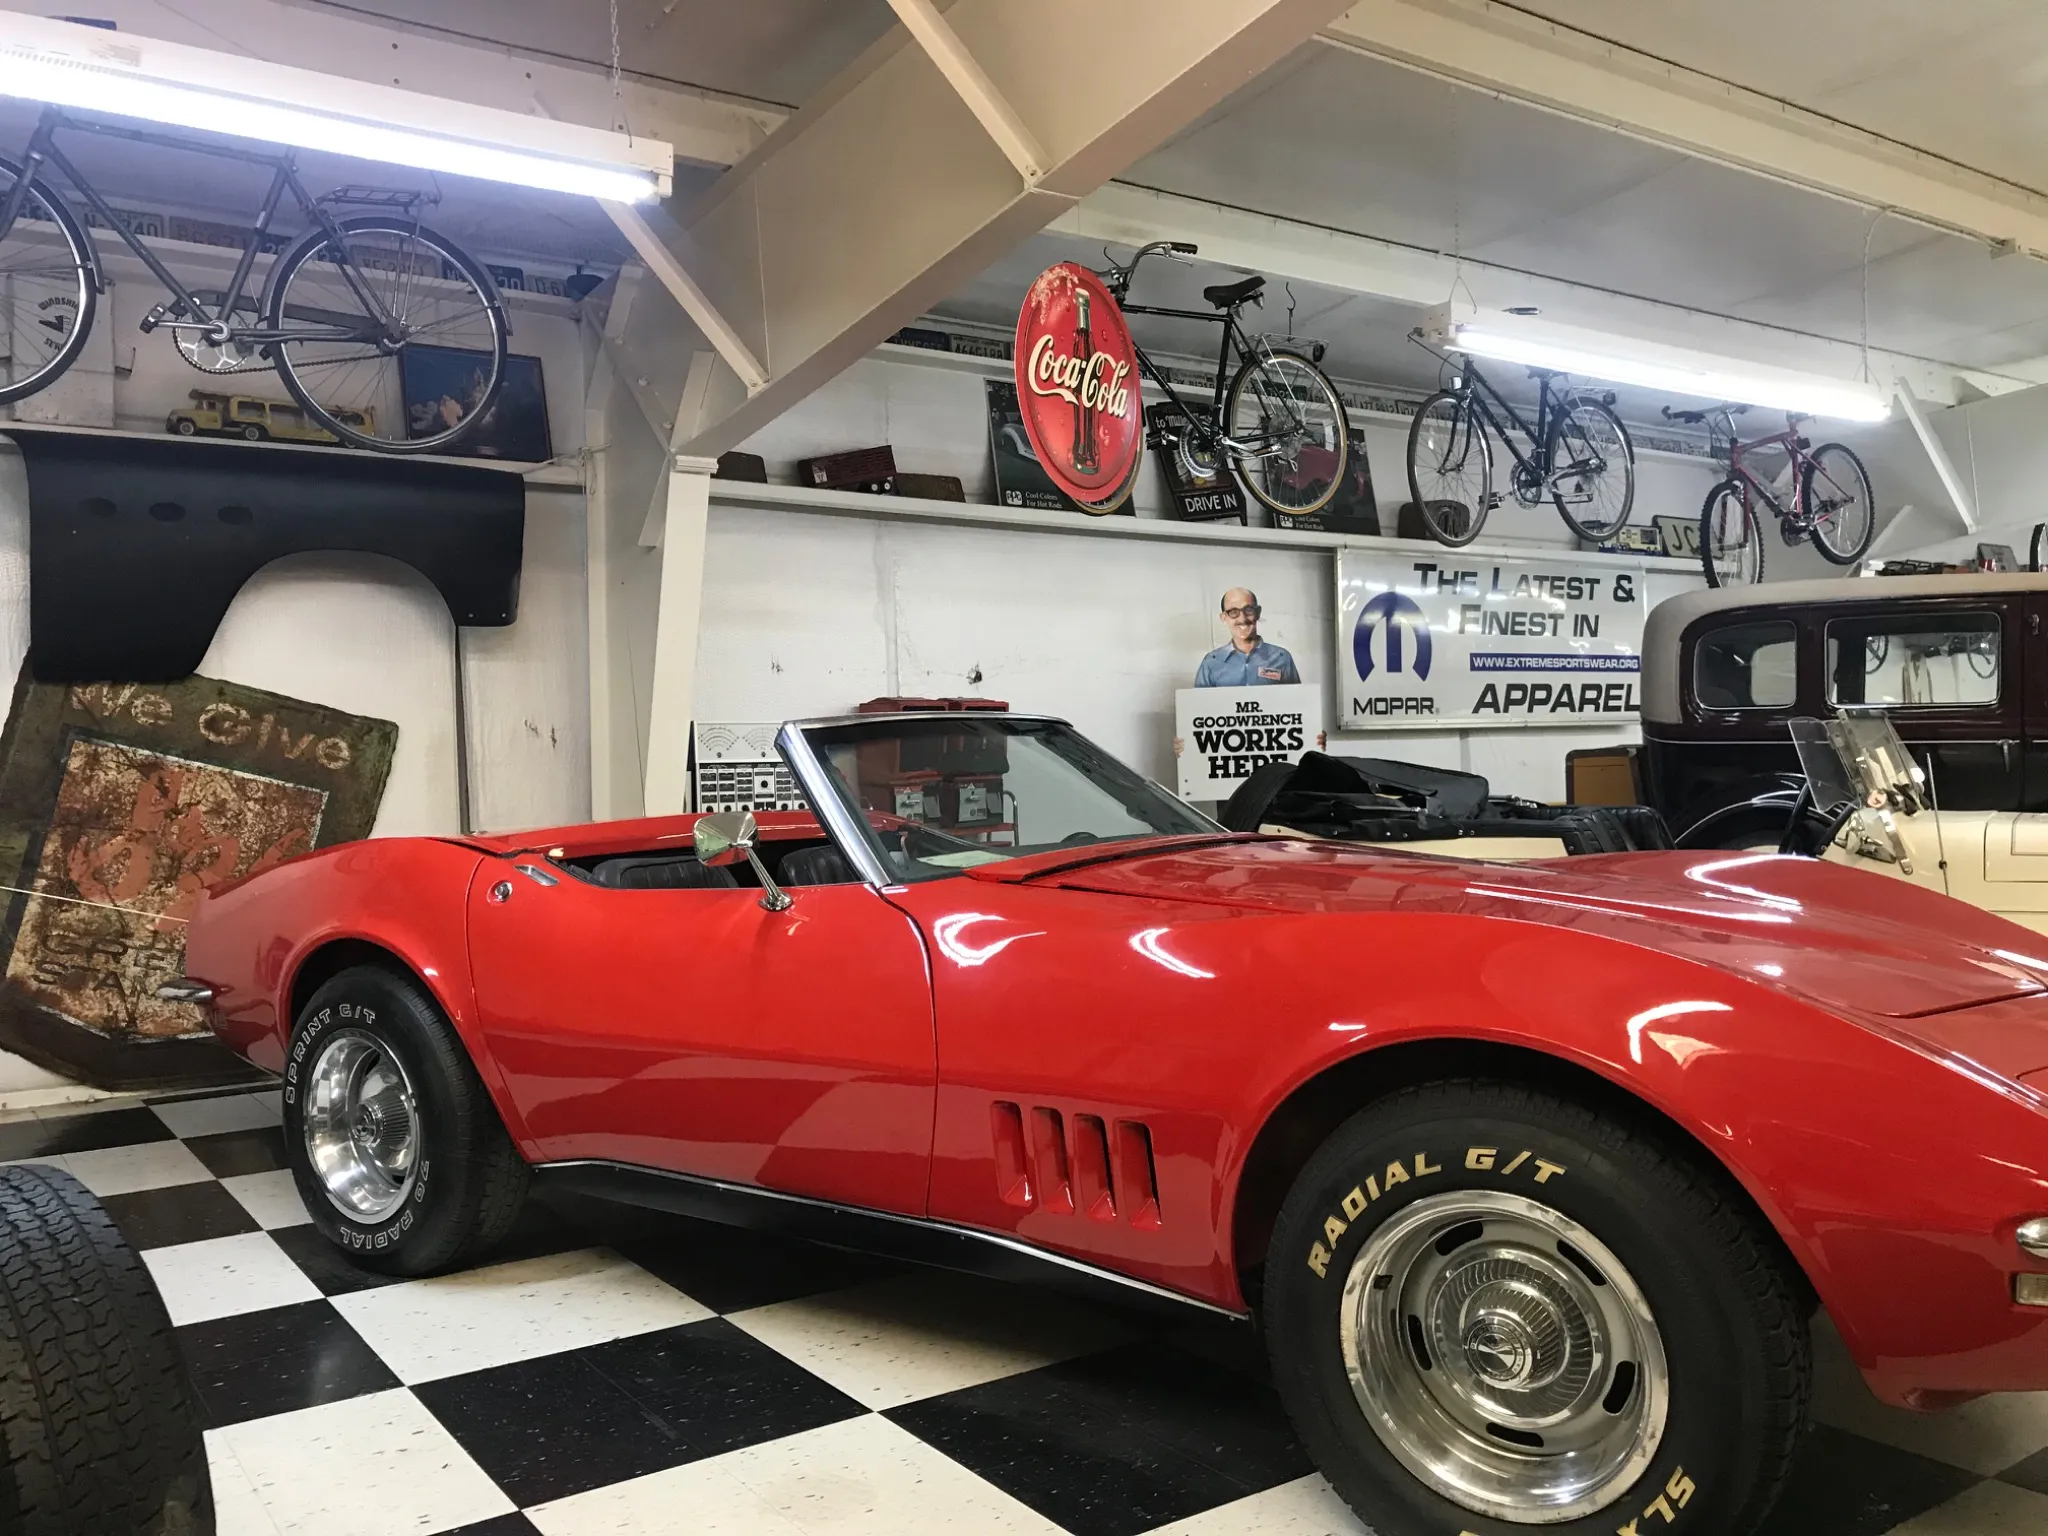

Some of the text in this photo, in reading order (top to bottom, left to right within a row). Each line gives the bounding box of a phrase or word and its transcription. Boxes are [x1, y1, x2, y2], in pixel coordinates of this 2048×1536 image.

[1155, 416, 1166, 428] to
[1025, 491, 1039, 499] Cool
[1184, 494, 1238, 512] DRIVE IN
[1413, 563, 1635, 603] THE LATEST &
[1458, 604, 1599, 638] FINEST IN
[1472, 656, 1639, 670] WWW.EXTREMESPORTSWEAR.ORG
[1235, 701, 1263, 713] MR.
[1353, 697, 1434, 716] MOPAR
[1471, 683, 1641, 714] APPAREL
[1193, 713, 1303, 729] GOODWRENCH
[199, 702, 351, 769] Give
[1193, 727, 1304, 754] WORKS
[1208, 753, 1288, 779] HE
[285, 1008, 331, 1104] SPRINT
[1307, 1146, 1568, 1280] RADIAL G/T
[339, 1210, 414, 1250] RADIAL
